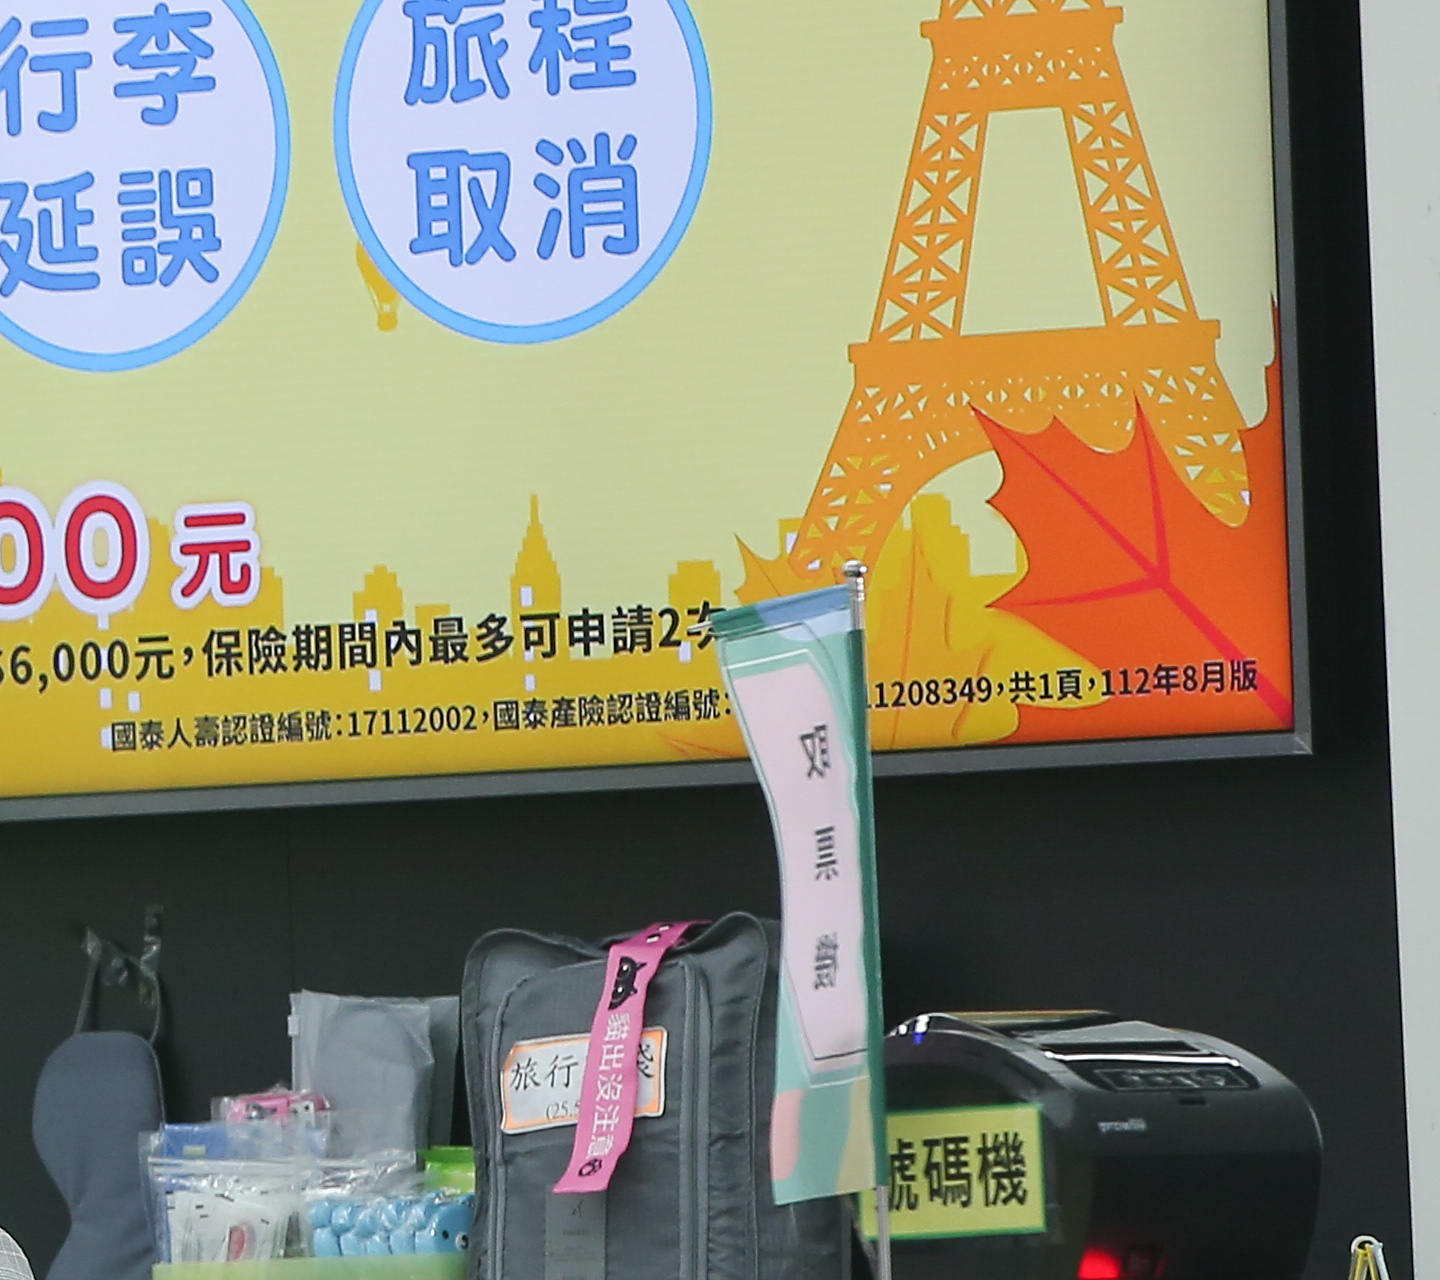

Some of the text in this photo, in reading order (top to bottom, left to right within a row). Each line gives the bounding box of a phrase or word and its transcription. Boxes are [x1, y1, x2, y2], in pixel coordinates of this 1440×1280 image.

[407, 133, 642, 269] 取消
[867, 658, 1258, 710] 1208349，共1頁，112年8月版
